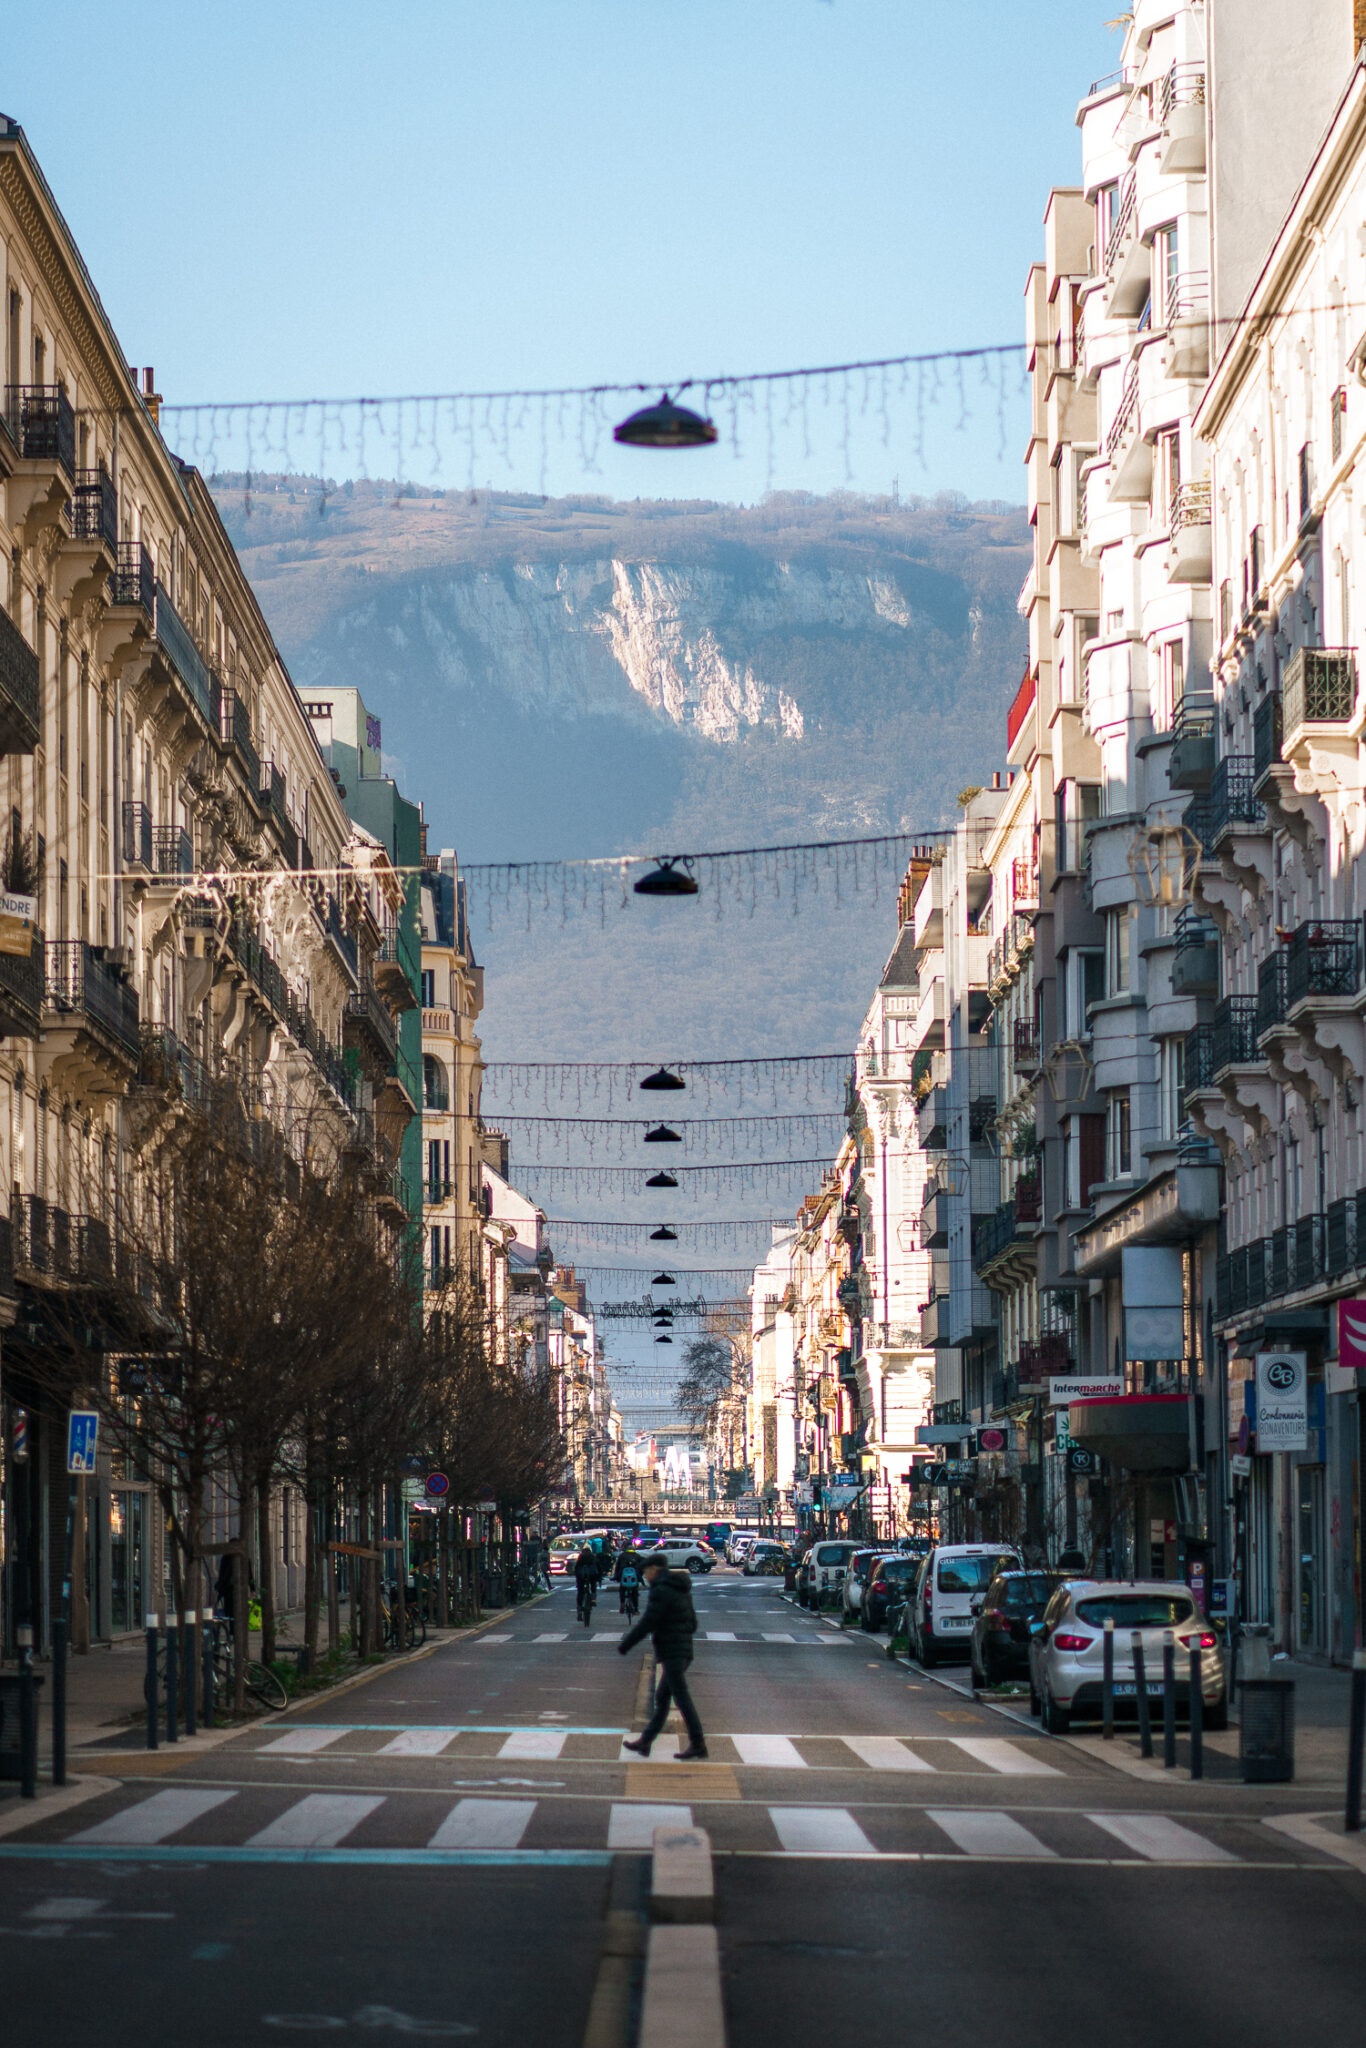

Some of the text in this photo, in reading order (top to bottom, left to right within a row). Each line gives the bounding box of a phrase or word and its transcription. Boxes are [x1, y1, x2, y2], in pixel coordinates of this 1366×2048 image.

[0, 898, 31, 915] NDRE
[1260, 1407, 1305, 1421] Cordonnerie
[1259, 1421, 1306, 1435] BONAVENTURE
